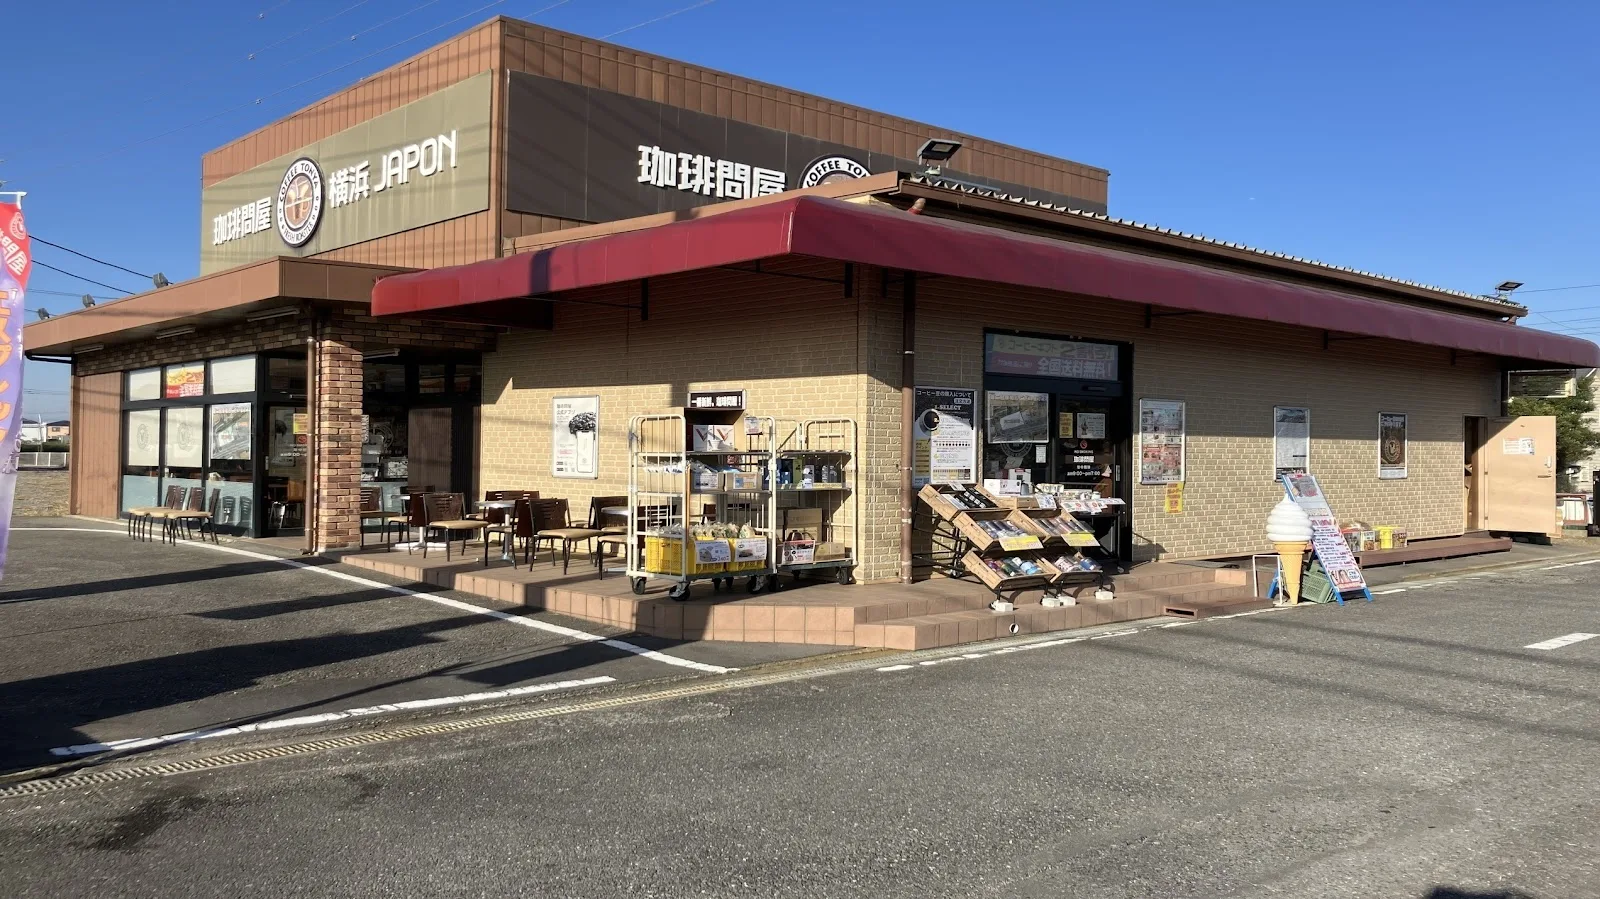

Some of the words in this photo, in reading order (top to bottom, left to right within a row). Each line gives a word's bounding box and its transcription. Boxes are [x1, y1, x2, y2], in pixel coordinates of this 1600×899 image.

[280, 165, 298, 202] COFFEE
[301, 163, 318, 189] TONYA
[329, 160, 371, 208] 横浜
[375, 130, 457, 192] JAPON
[638, 145, 786, 198] 珈琲問屋
[806, 160, 840, 188] COFFEE
[213, 197, 272, 245] 珈琲問屋
